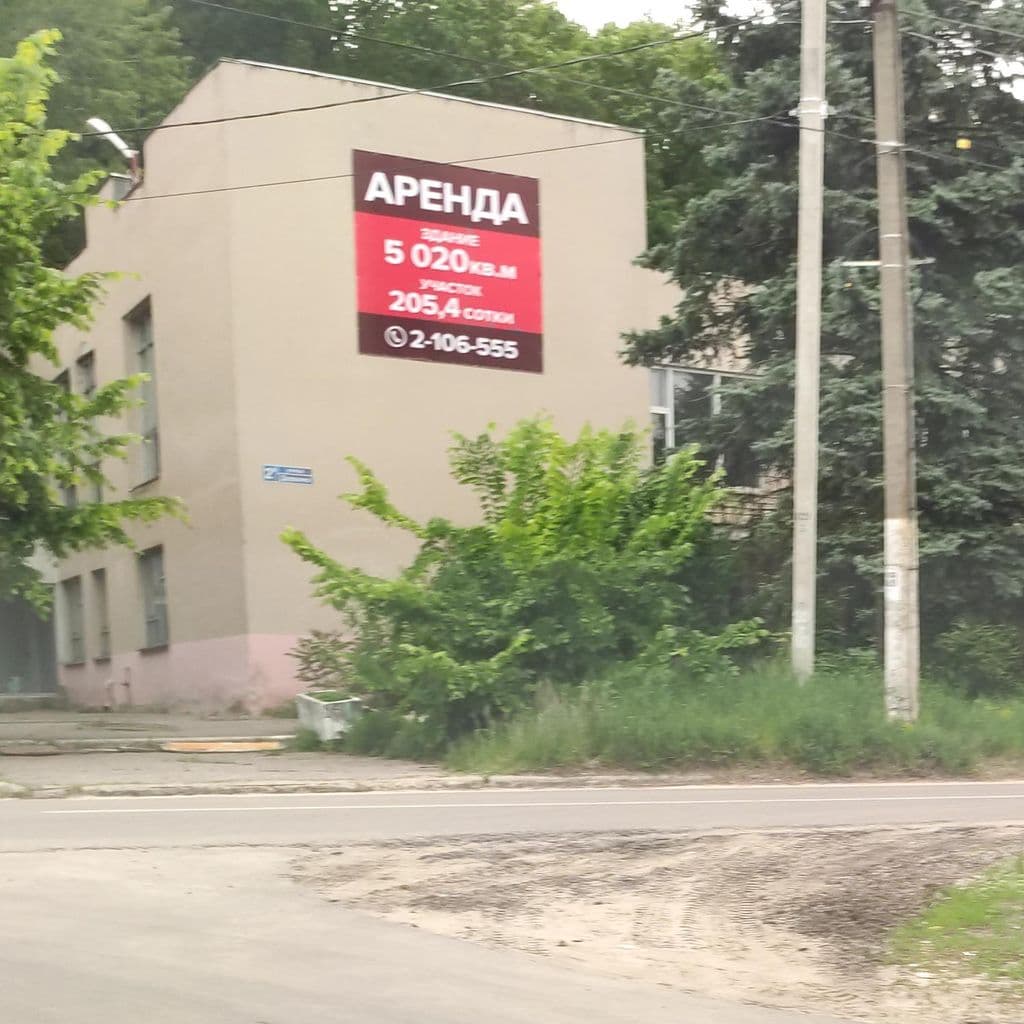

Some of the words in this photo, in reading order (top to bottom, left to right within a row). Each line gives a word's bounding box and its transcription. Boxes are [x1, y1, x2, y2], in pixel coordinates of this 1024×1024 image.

[364, 172, 529, 225] АРЕНДА
[420, 228, 480, 247] ЗДАНИЕ
[383, 239, 405, 264] 5
[419, 278, 483, 297] УЧАСТОК
[388, 290, 461, 319] 205,4
[408, 329, 519, 359] 2-106-555
